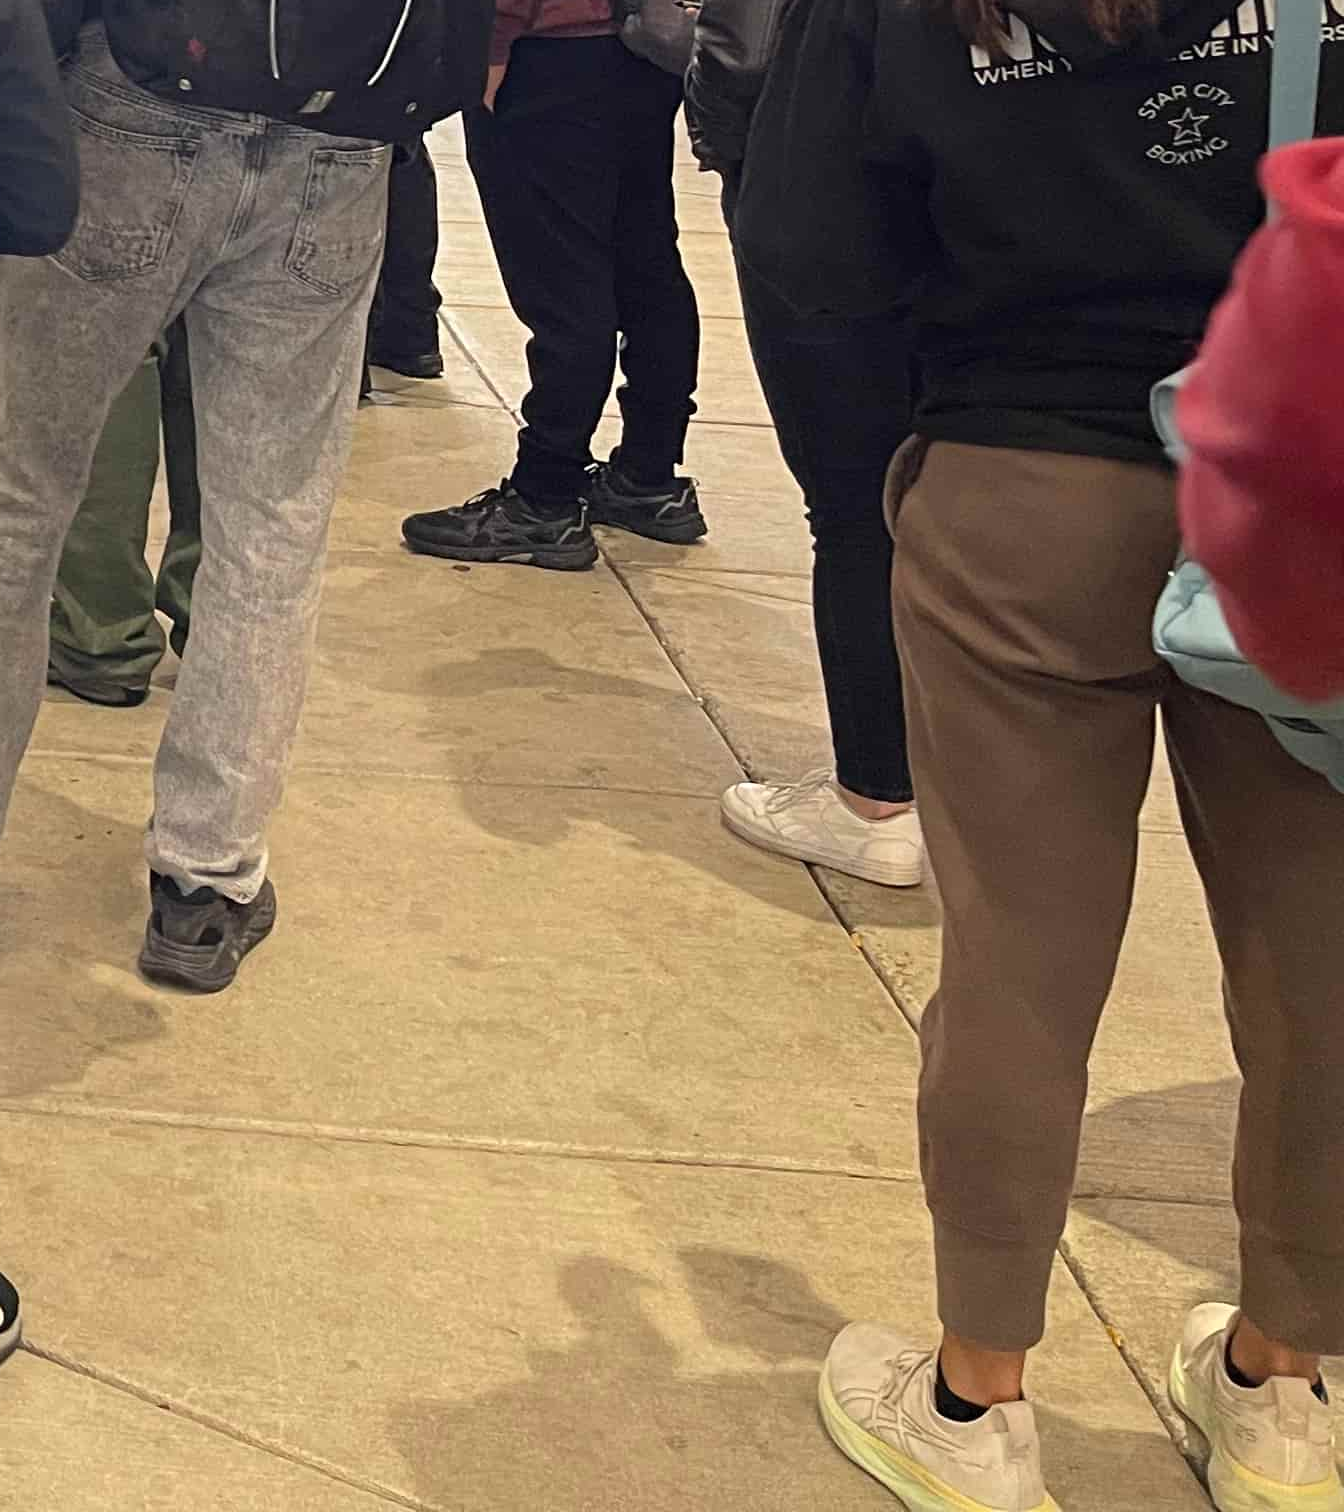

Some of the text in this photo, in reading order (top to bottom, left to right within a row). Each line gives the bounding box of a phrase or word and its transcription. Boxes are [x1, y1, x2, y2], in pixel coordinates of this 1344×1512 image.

[1233, 37, 1259, 55] IN
[973, 59, 1055, 86] WHEN
[1137, 83, 1236, 120] STAR CITY
[1145, 136, 1229, 164] BOXING
